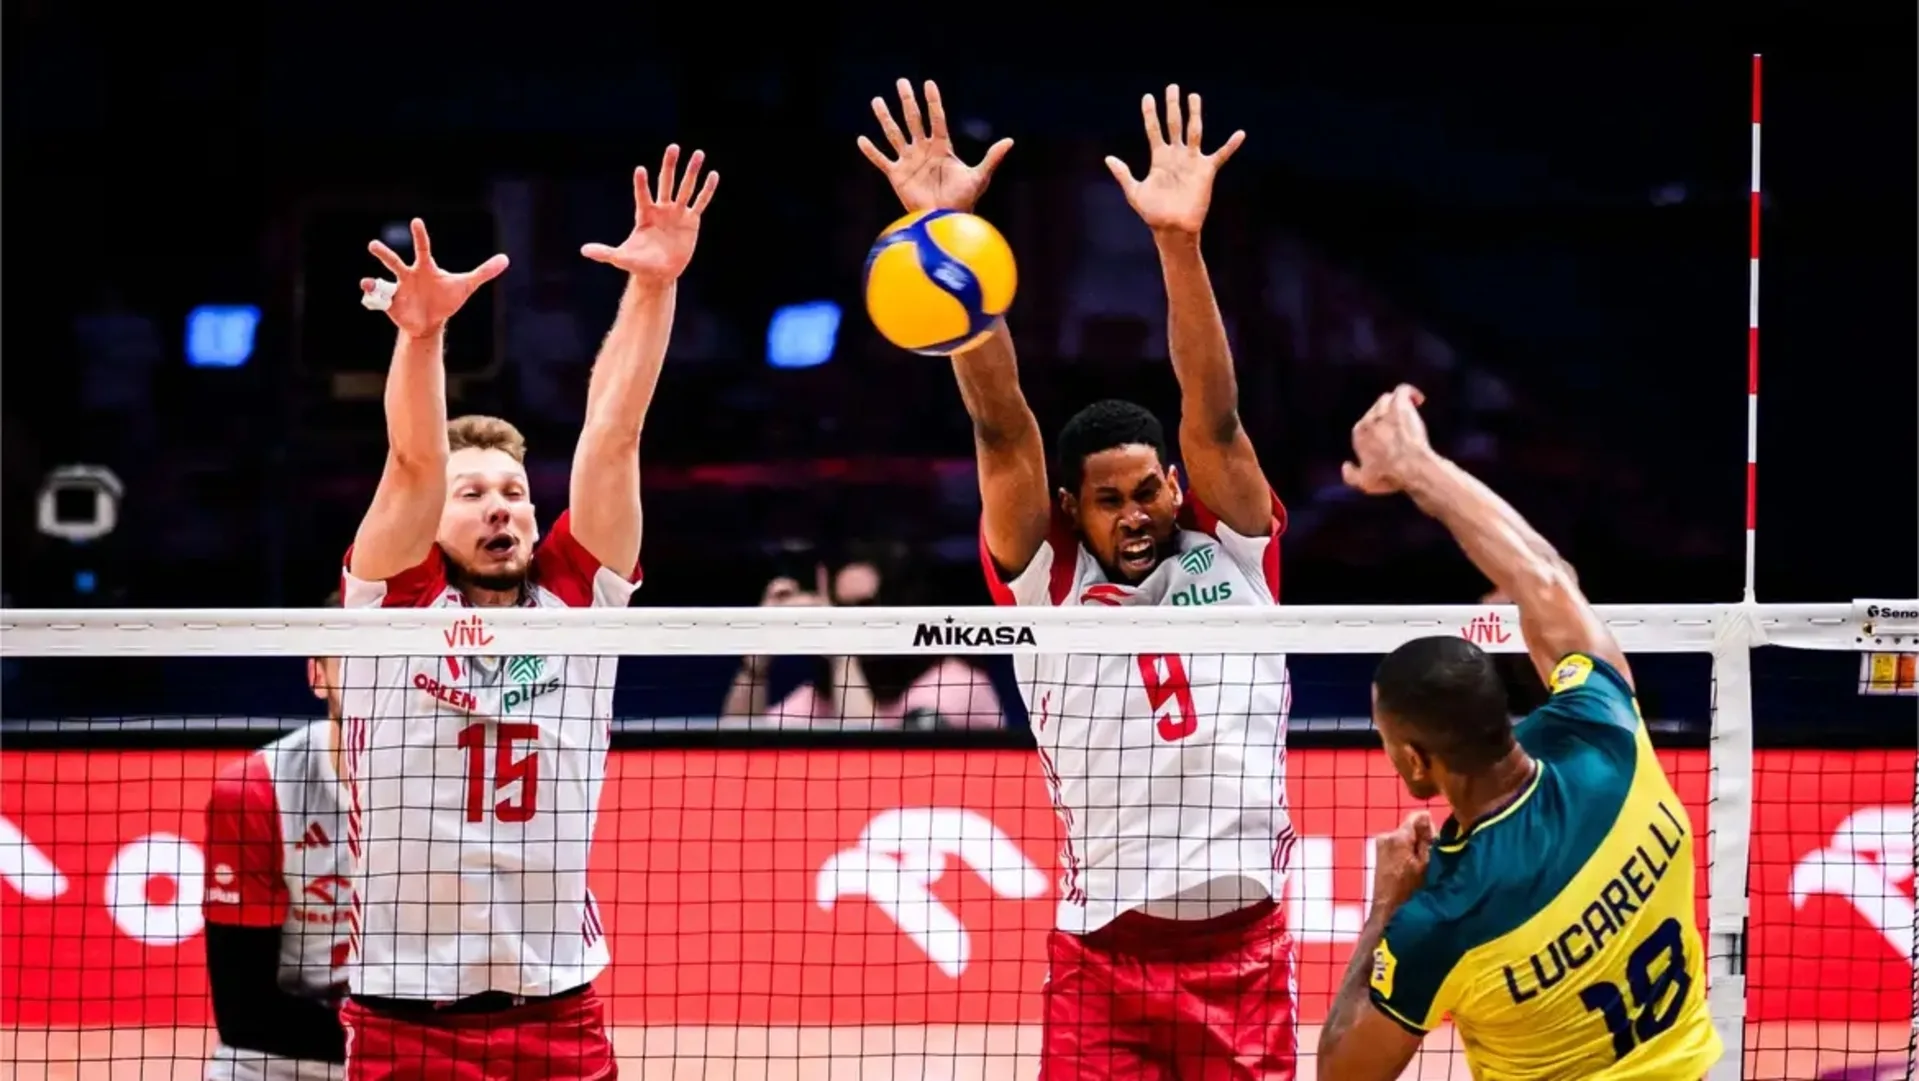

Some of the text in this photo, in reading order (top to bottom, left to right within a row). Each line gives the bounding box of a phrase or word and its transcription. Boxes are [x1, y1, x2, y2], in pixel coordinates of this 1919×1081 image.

[1171, 581, 1233, 606] plus
[443, 614, 495, 649] VNL
[912, 615, 1038, 647] MIKASA
[1461, 611, 1512, 644] VNL
[413, 672, 478, 711] ORLEN
[503, 676, 560, 714] plus
[1137, 652, 1199, 743] 9
[457, 722, 540, 823] 15
[1502, 801, 1685, 1005] LUCARELLI
[1577, 917, 1692, 1061] 18
